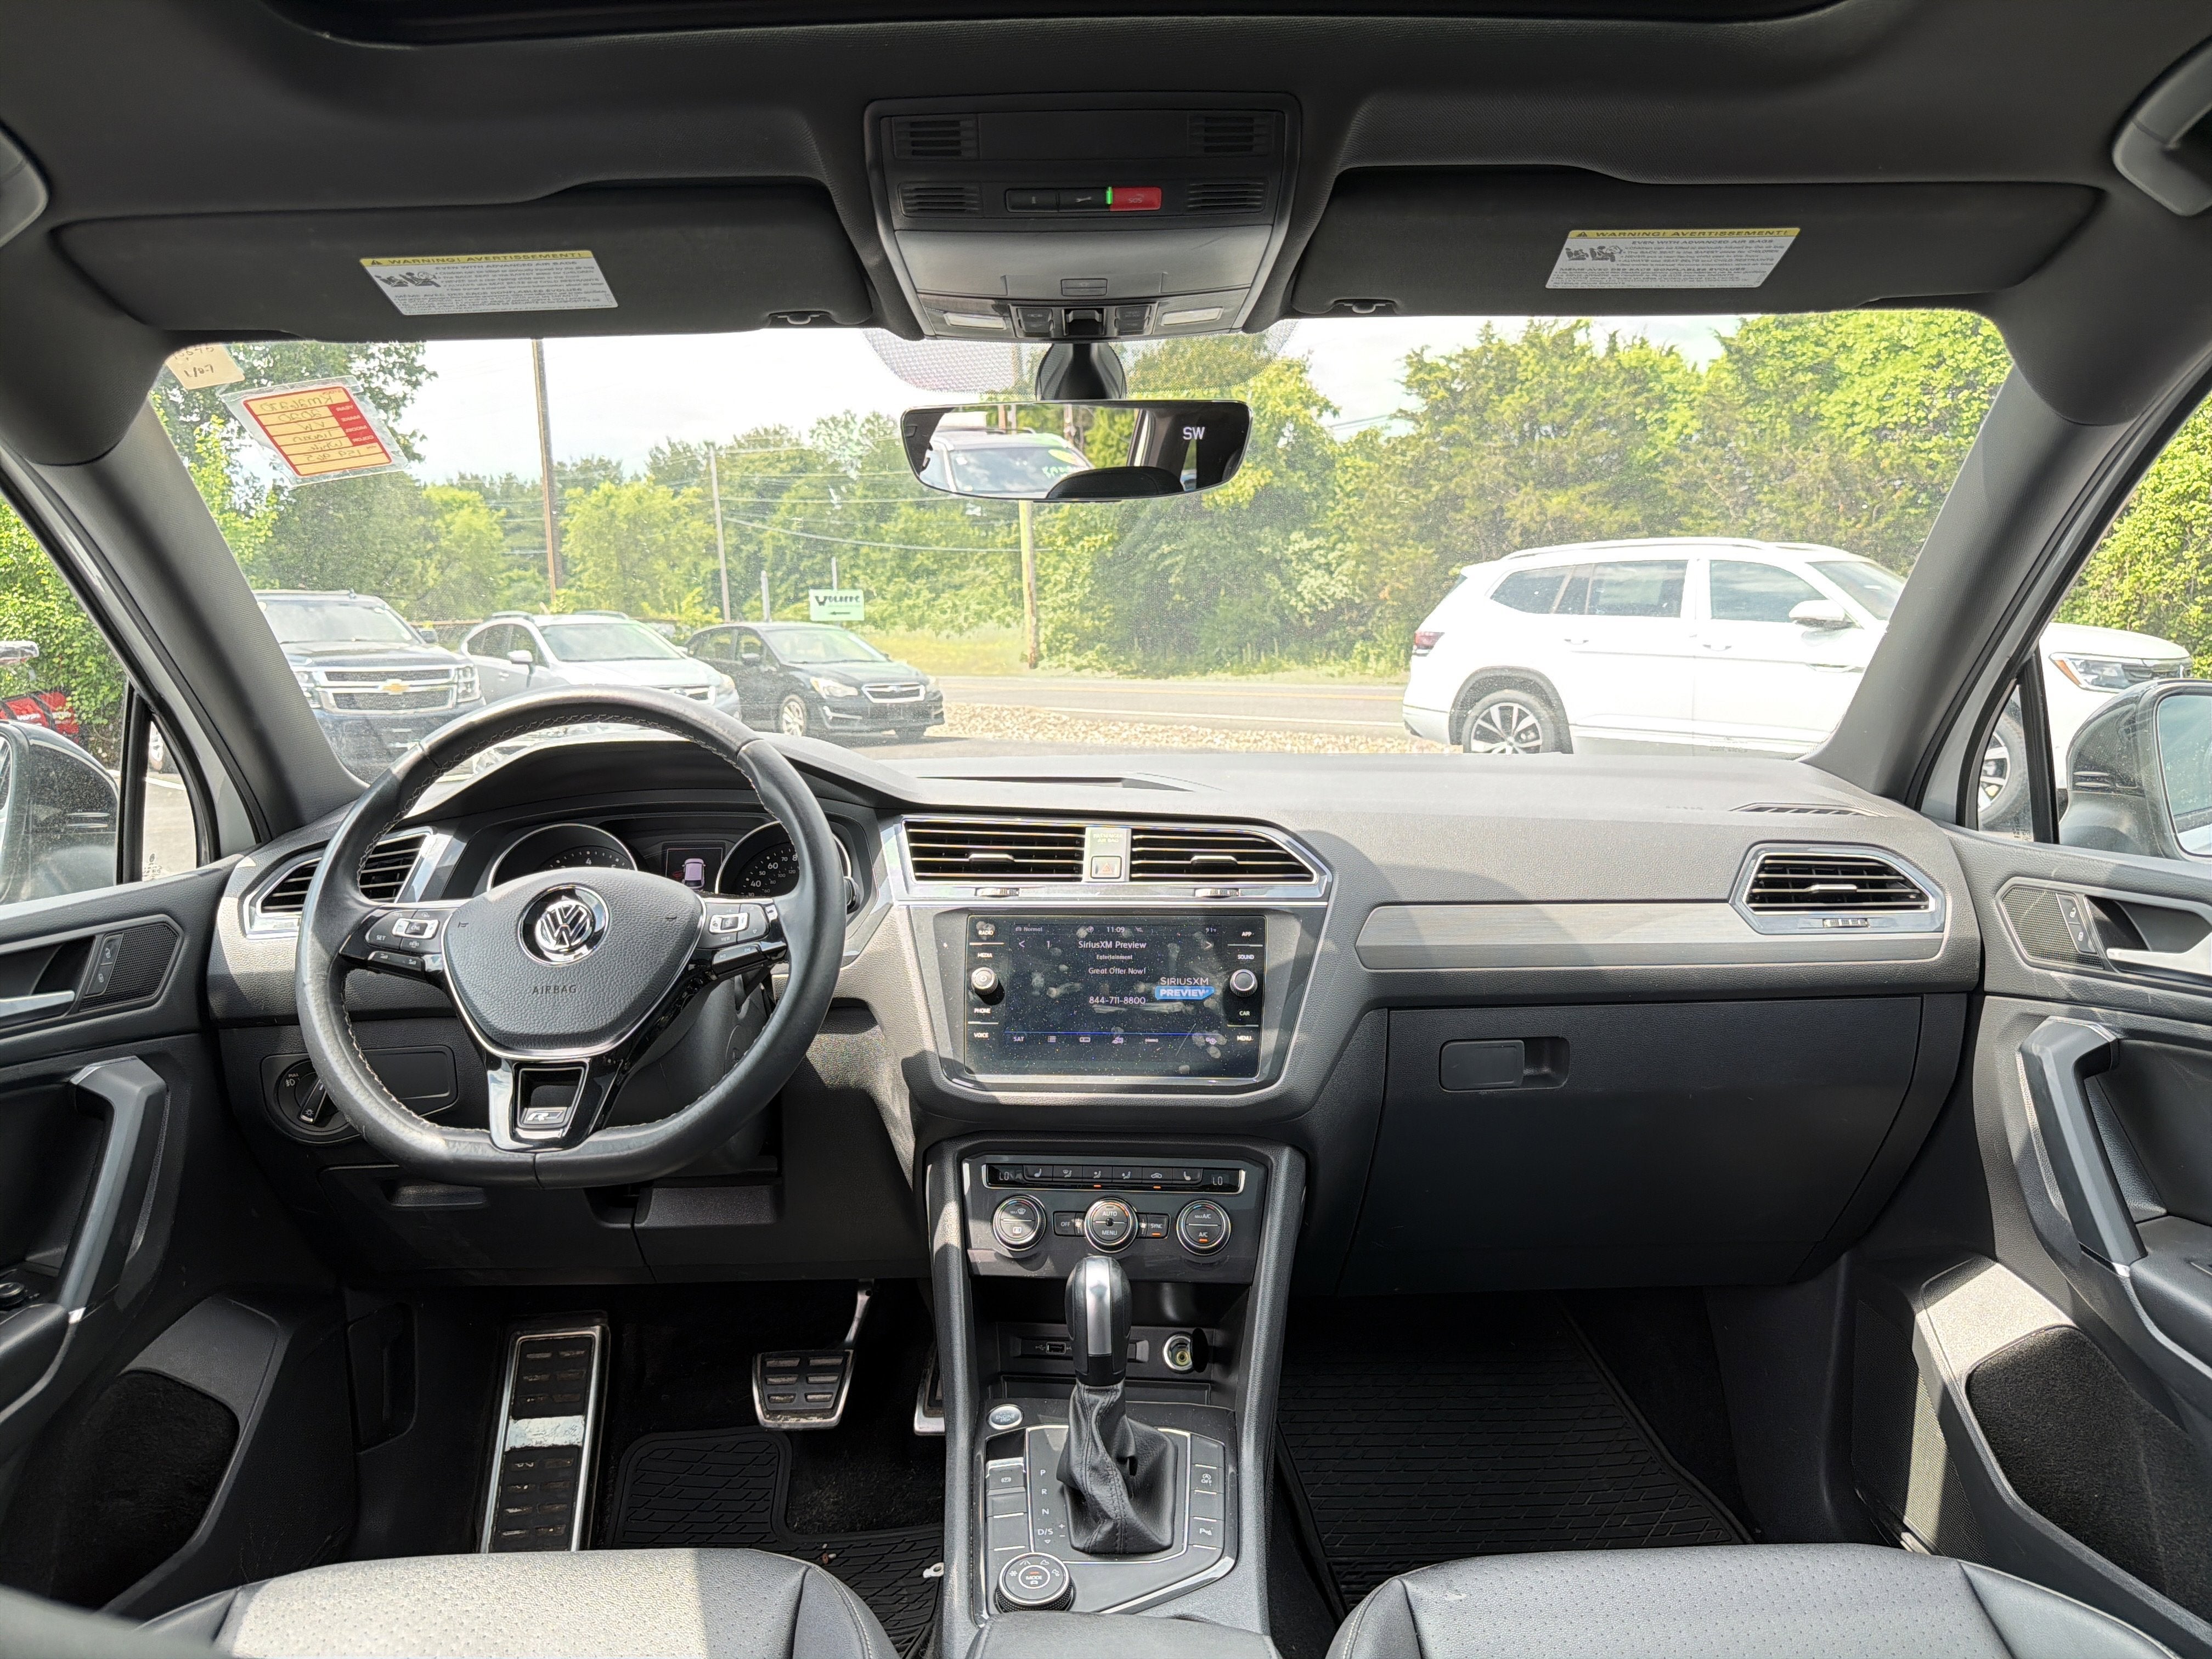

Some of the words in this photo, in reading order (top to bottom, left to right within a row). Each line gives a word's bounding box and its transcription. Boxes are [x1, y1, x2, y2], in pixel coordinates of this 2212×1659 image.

[467, 253, 582, 262] AVERTISSEMENT!
[1183, 426, 1205, 440] SW
[1078, 940, 1113, 949] SiriusXM
[1115, 940, 1147, 949] Preview
[1160, 977, 1209, 985] SIRIUSXM
[532, 984, 577, 995] AIRBAG
[1160, 989, 1209, 997] PREVIEW
[1088, 996, 1147, 1005] 844-711-8800
[999, 1171, 1009, 1181] LO
[1212, 1176, 1223, 1186] LO
